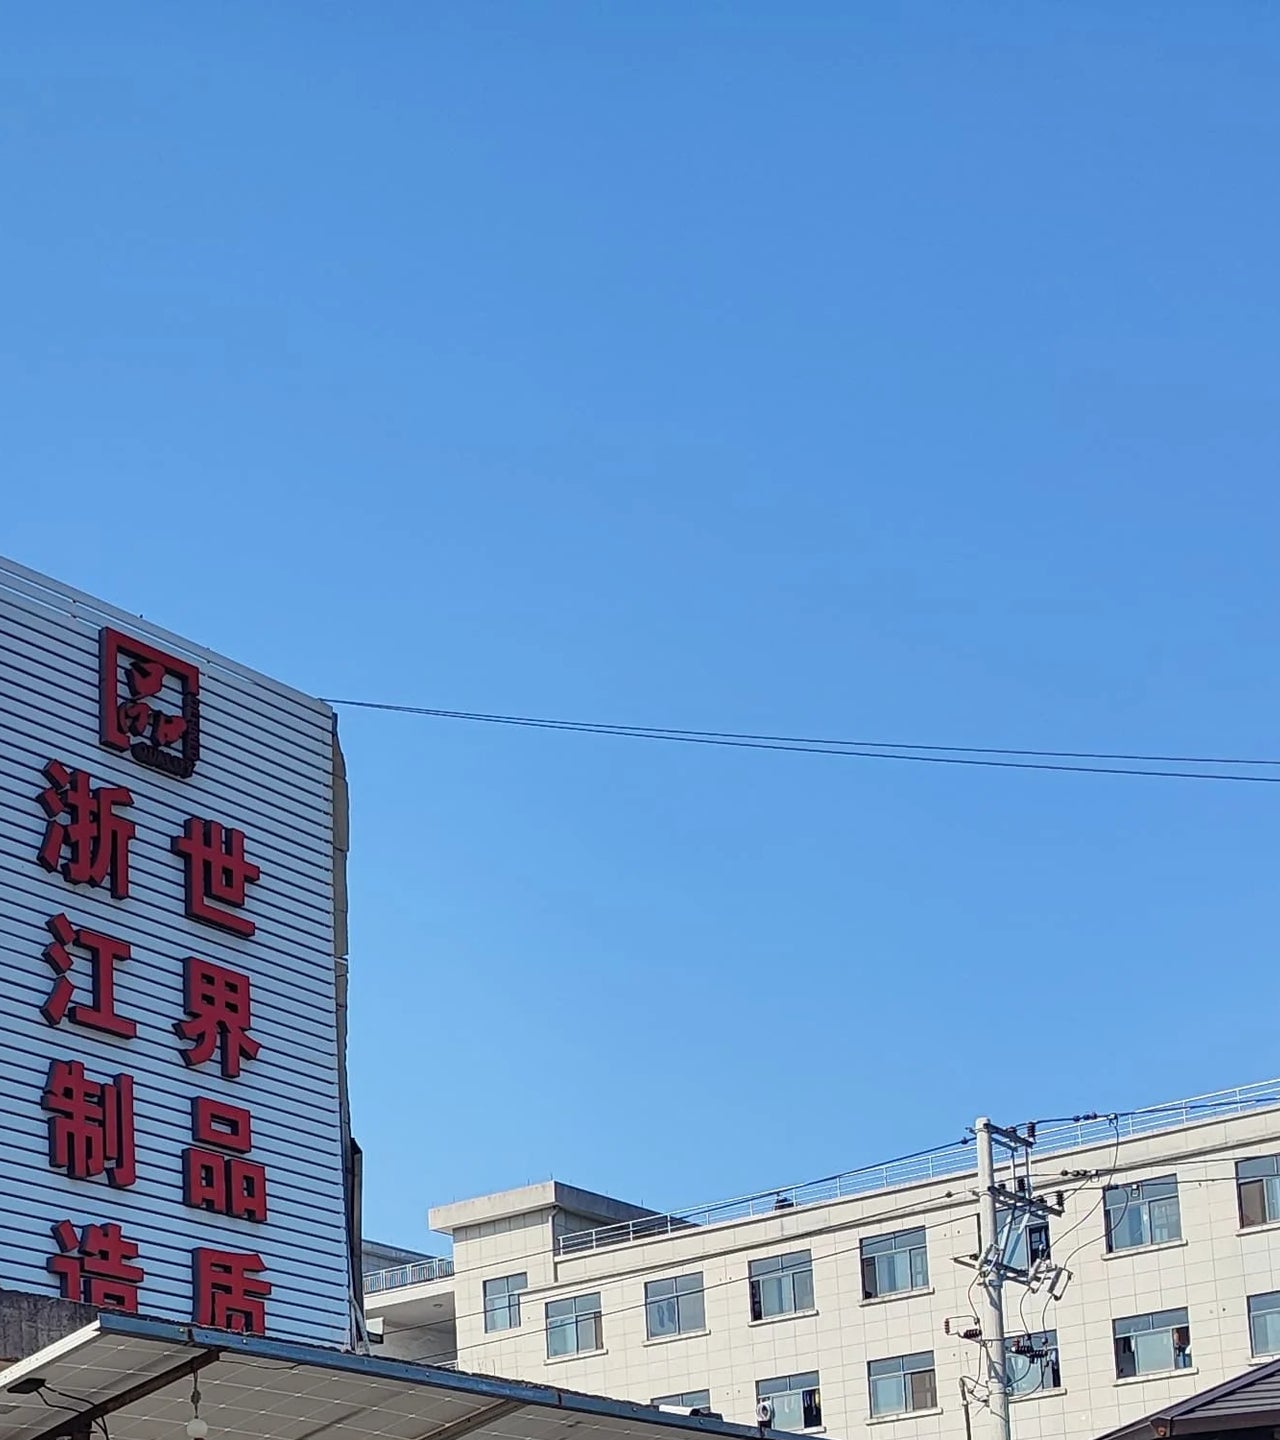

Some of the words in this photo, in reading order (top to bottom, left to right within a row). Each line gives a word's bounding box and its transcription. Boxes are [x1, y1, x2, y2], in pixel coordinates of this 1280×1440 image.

[35, 757, 144, 1312] 浙江制造
[171, 816, 273, 1336] 世界品质
